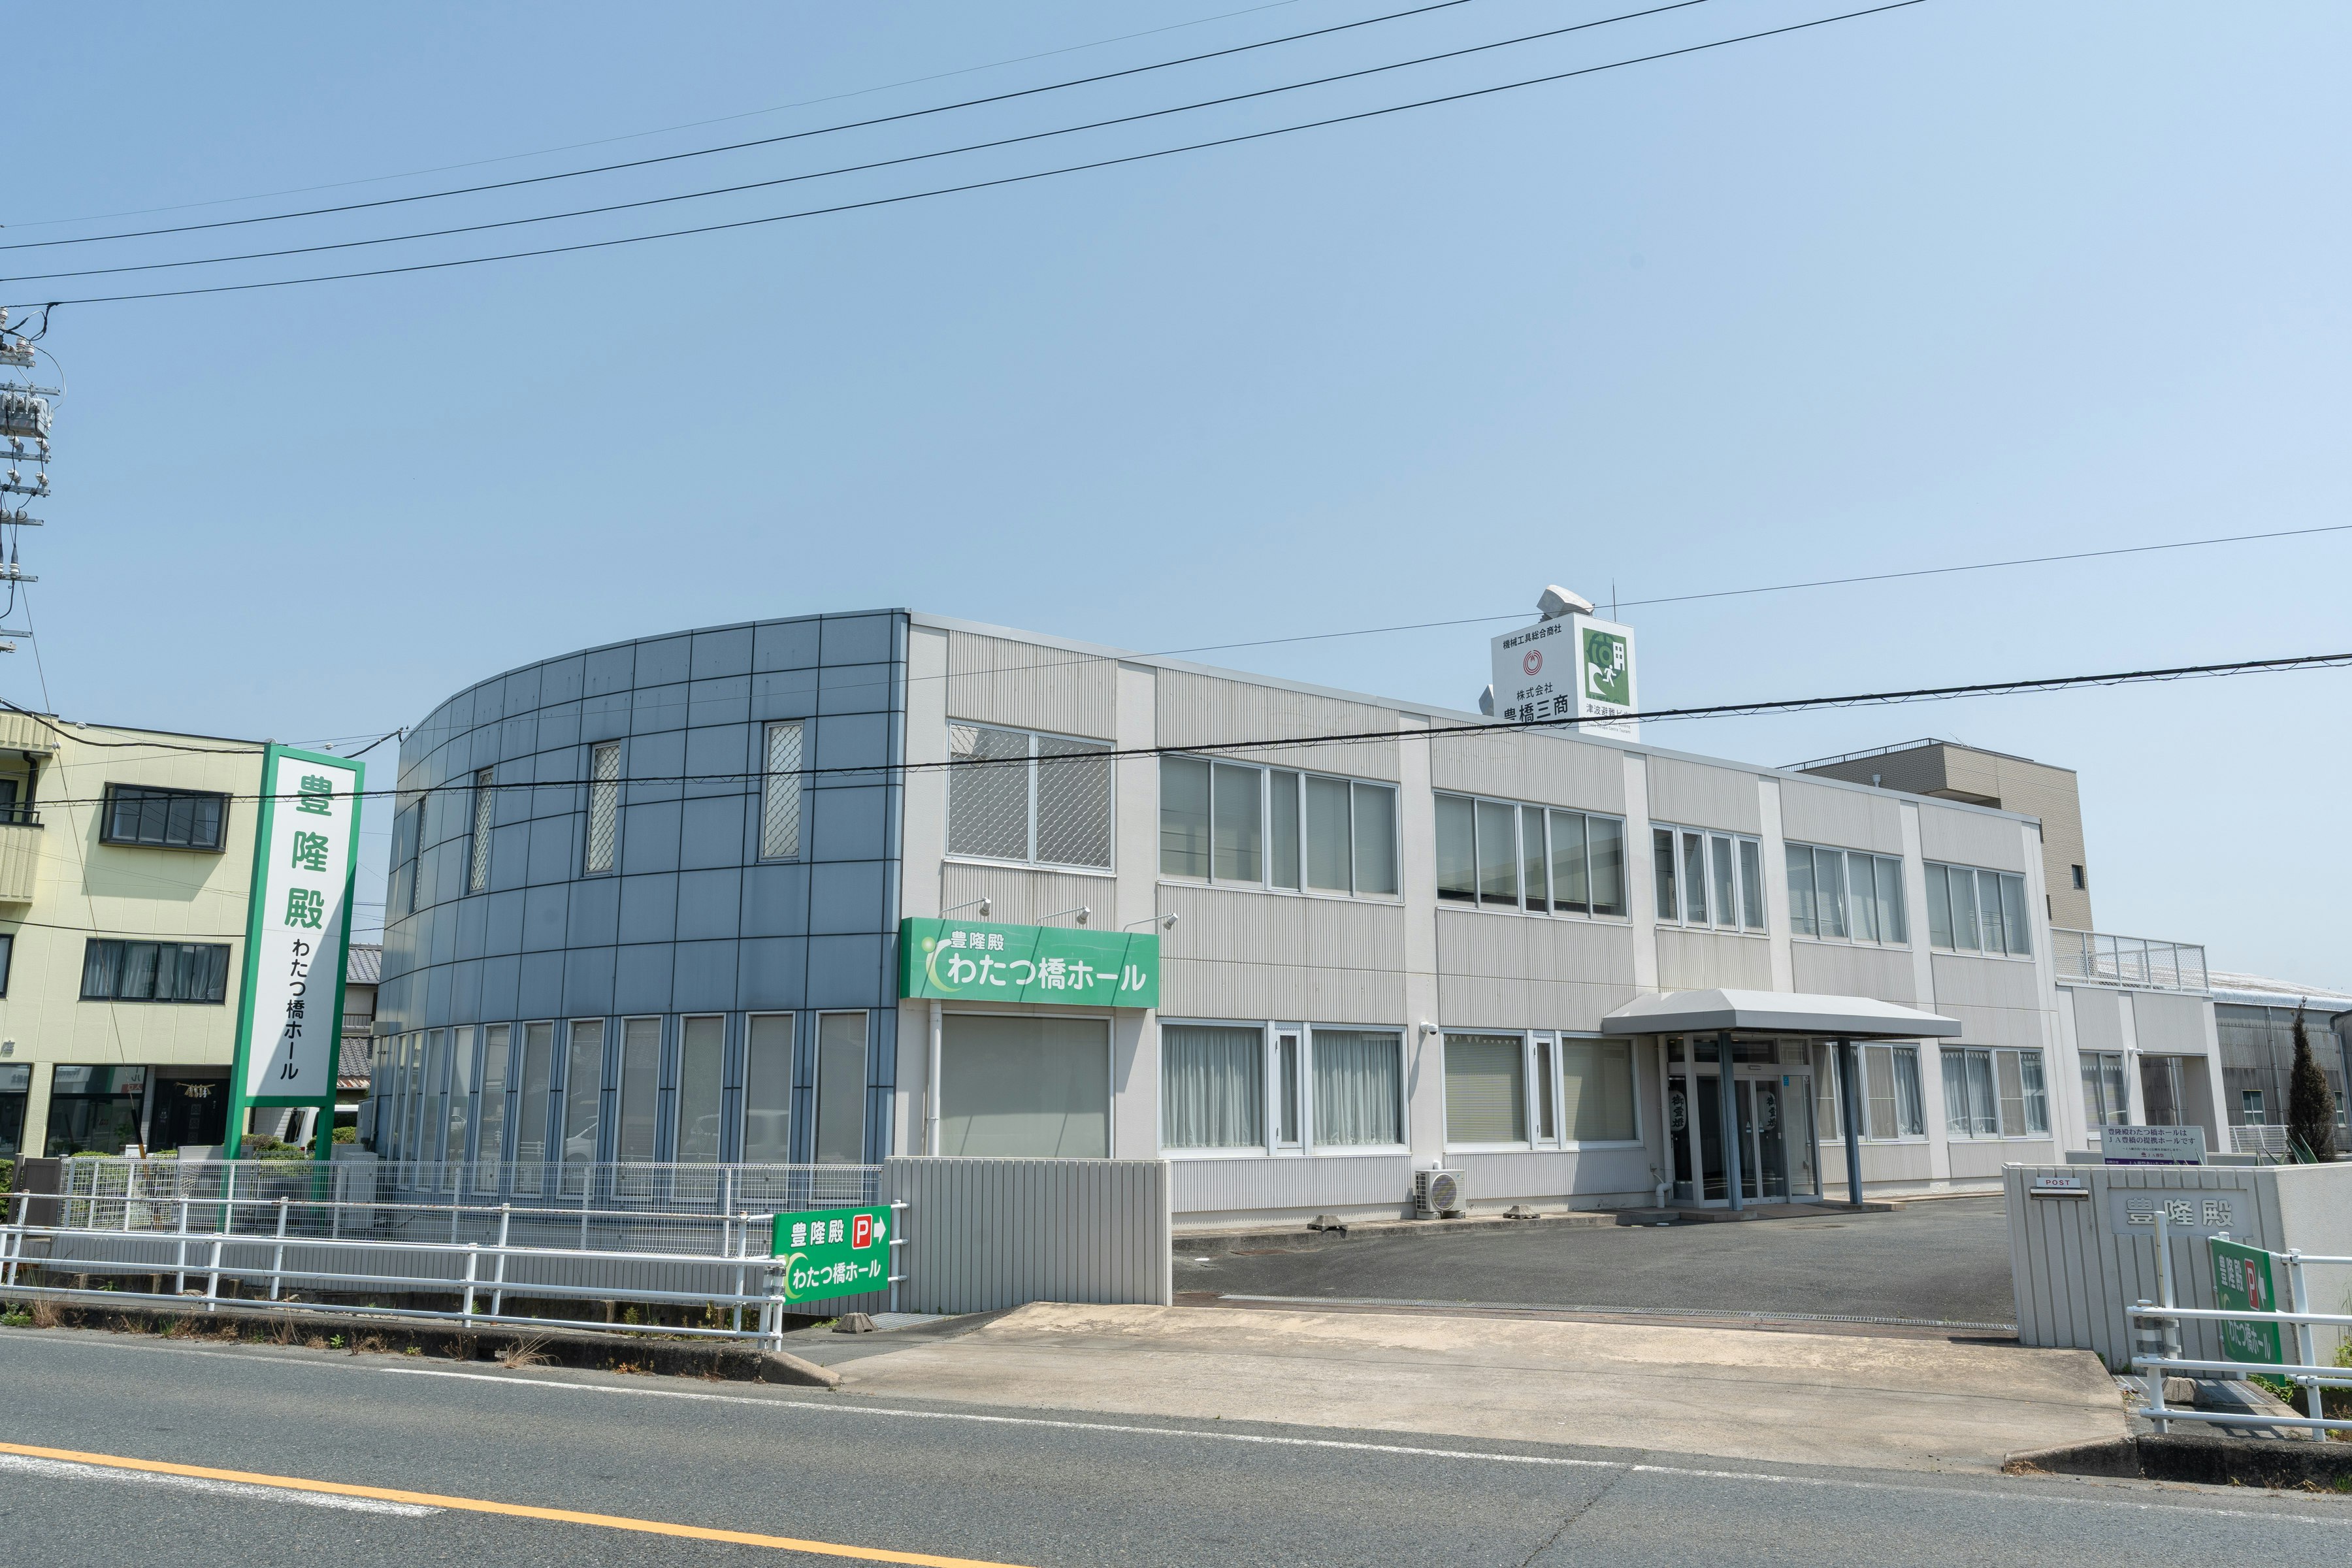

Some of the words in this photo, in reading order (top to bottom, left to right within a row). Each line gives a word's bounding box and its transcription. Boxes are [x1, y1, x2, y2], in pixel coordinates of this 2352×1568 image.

[1503, 623, 1562, 650] 機械工具総合商社
[1516, 681, 1554, 701] 株式会社
[284, 774, 333, 930] 豊隆殿
[949, 930, 1005, 951] 豊隆殿
[947, 952, 1147, 992] わたつ橋ホール
[280, 938, 310, 1080] わたつ橋ホール
[2109, 1136, 2196, 1145] JA豊橋の提携ホールです
[2126, 1198, 2234, 1227] 豊隆殿
[789, 1218, 844, 1248] 豊隆殿
[857, 1220, 869, 1244] P
[792, 1259, 881, 1290] わたつ橋ホール
[2218, 1254, 2244, 1293] 豊隆殿
[2247, 1267, 2257, 1301] P
[2228, 1319, 2271, 1360] わたつ橋ホール
